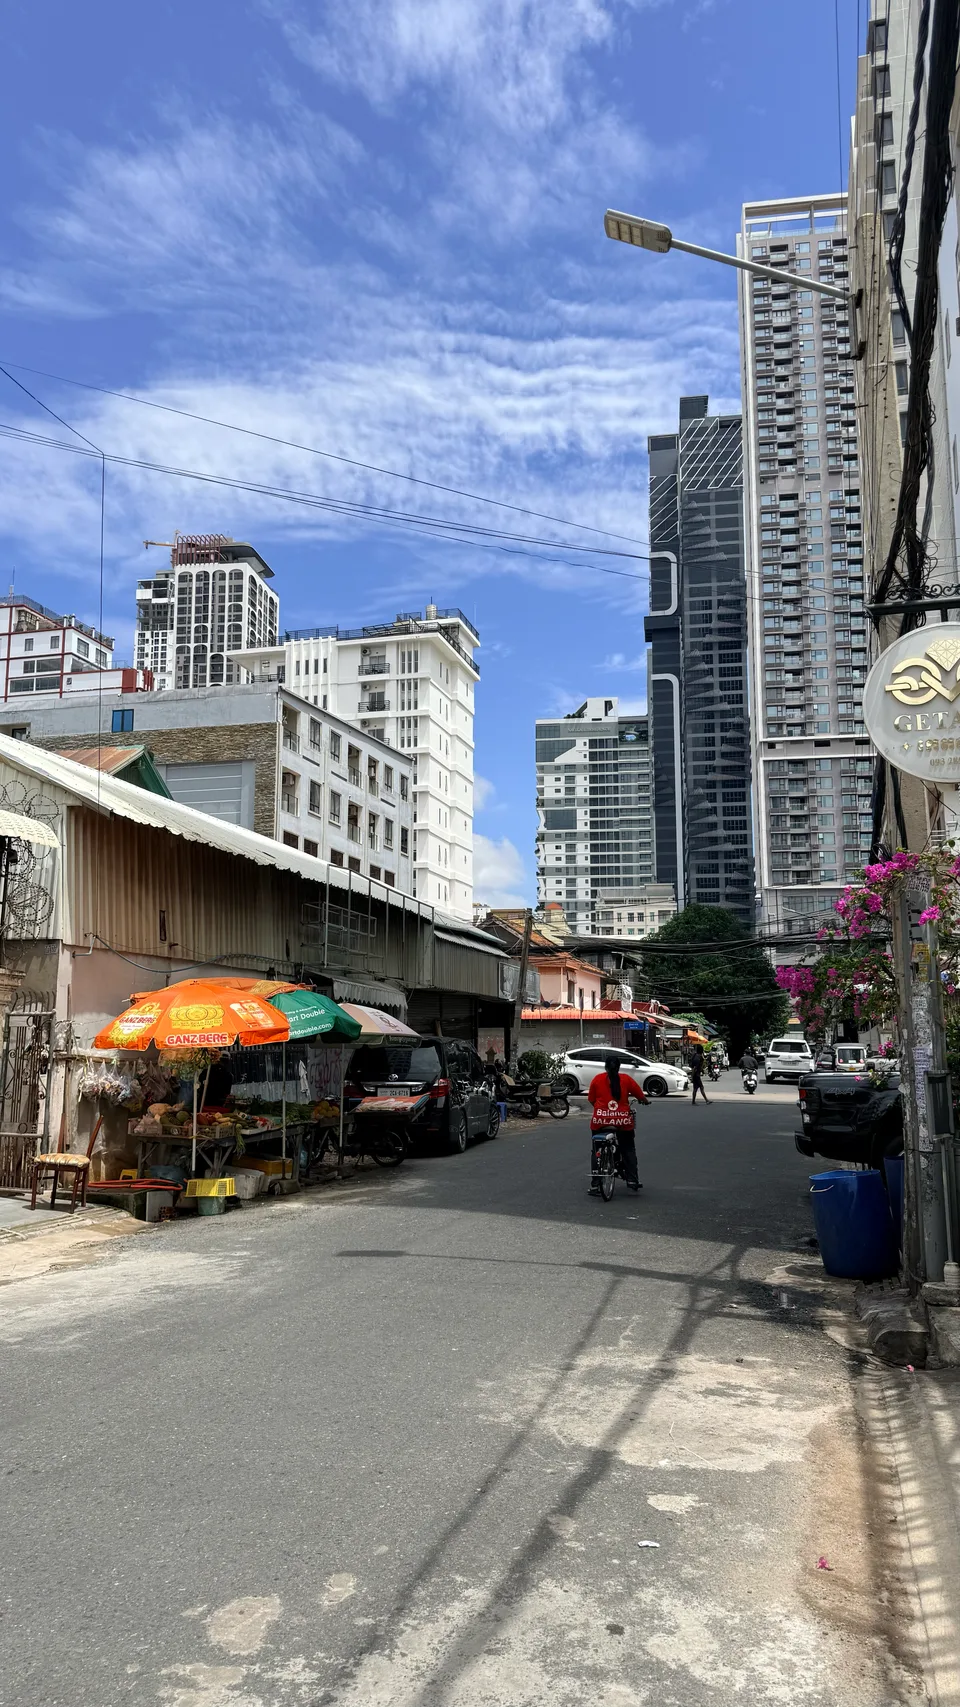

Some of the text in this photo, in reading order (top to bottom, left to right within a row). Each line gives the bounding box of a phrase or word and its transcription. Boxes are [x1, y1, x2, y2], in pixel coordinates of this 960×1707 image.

[300, 1008, 326, 1020] Double
[289, 1023, 332, 1036] artdouble.com
[166, 1033, 228, 1046] GANZBERG
[596, 1108, 629, 1117] Balance
[592, 1117, 632, 1125] BALANCE
